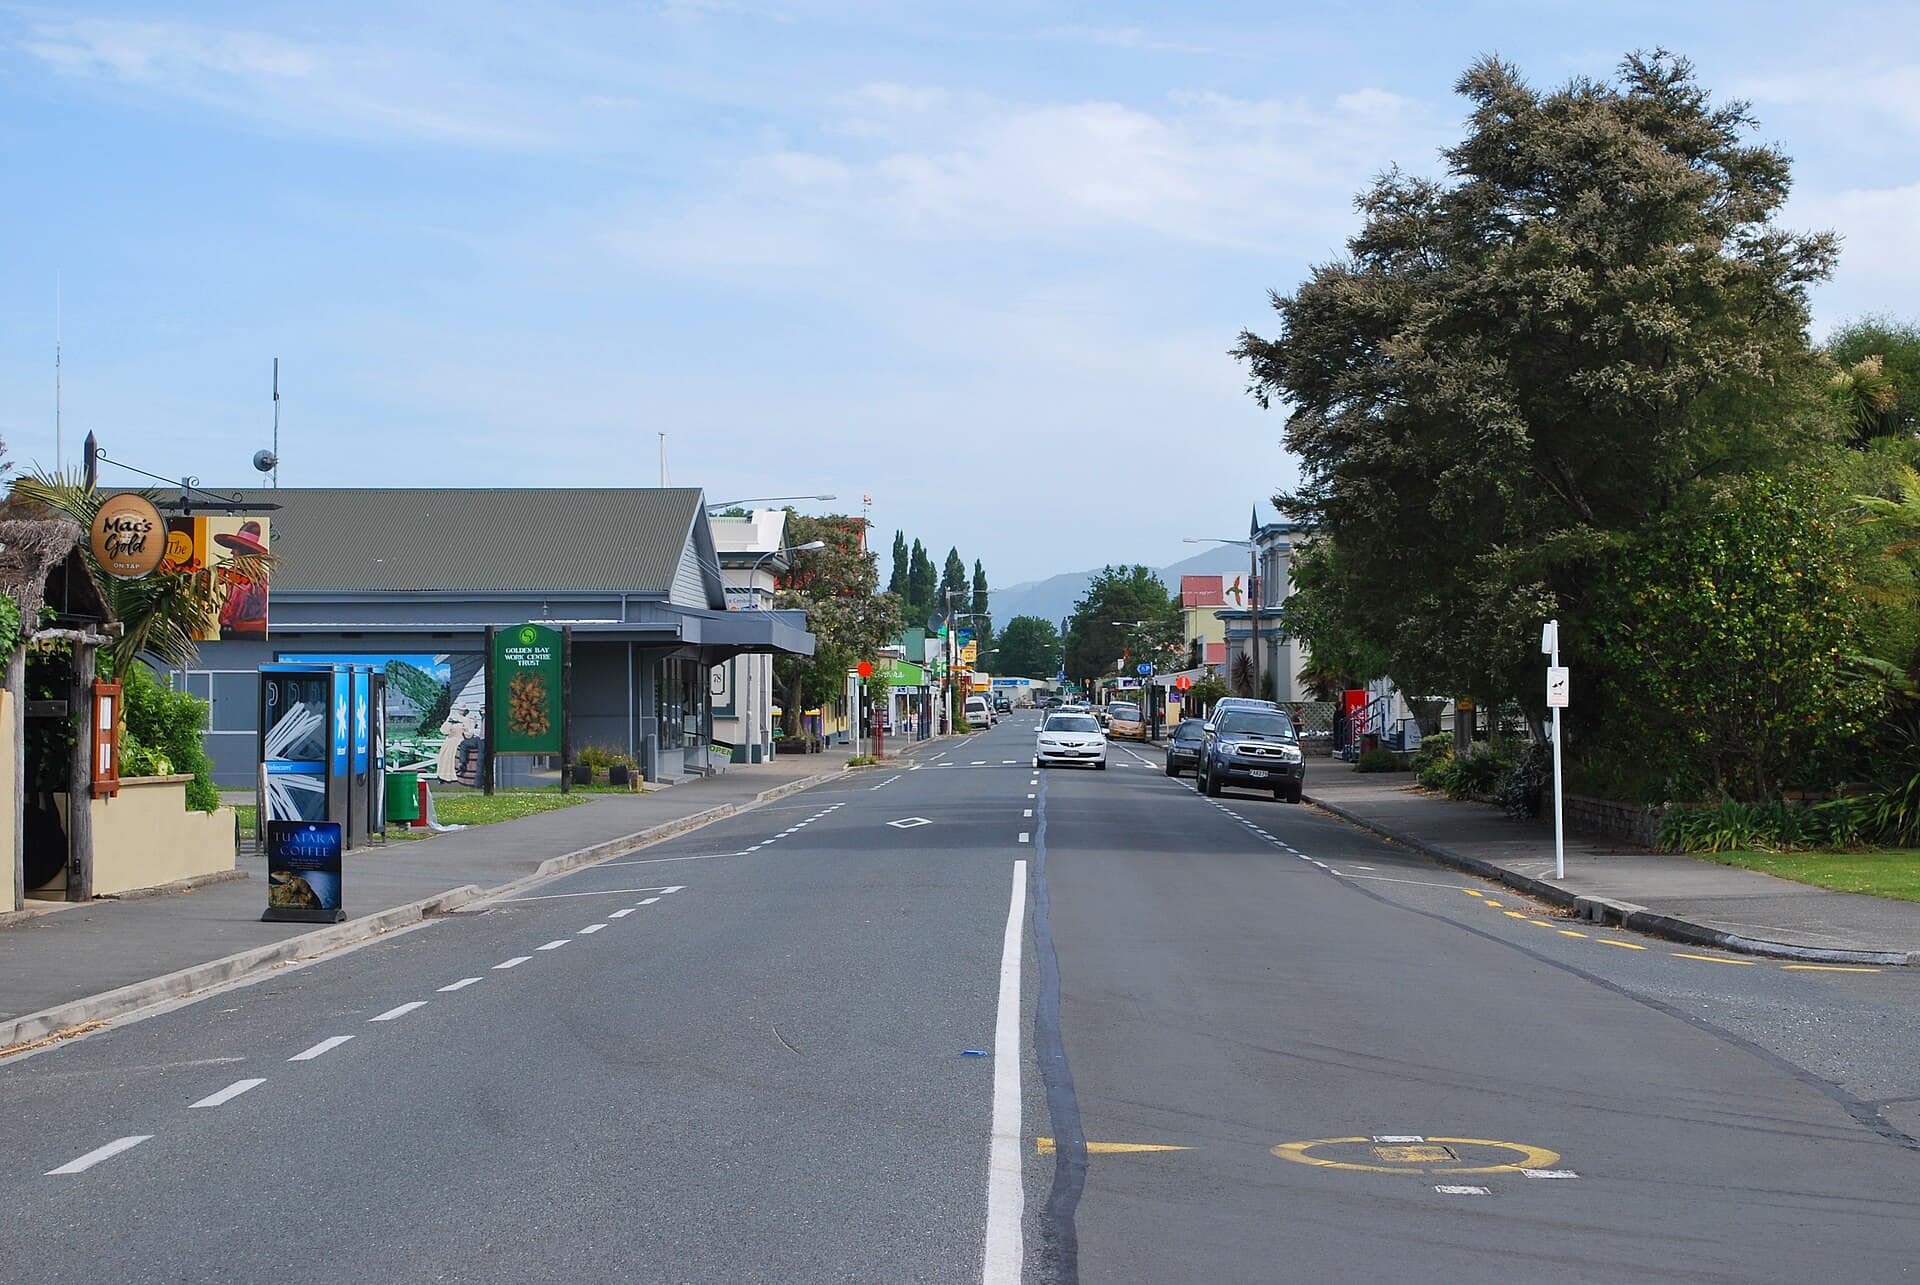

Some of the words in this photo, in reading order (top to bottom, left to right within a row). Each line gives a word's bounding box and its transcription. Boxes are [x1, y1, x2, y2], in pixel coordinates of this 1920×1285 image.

[103, 516, 153, 533] Mac's
[104, 533, 147, 560] Gold
[166, 540, 187, 555] The
[713, 673, 722, 683] 78
[709, 745, 735, 757] OPEN
[274, 832, 336, 844] TUATARA
[280, 845, 330, 857] COFFEE
